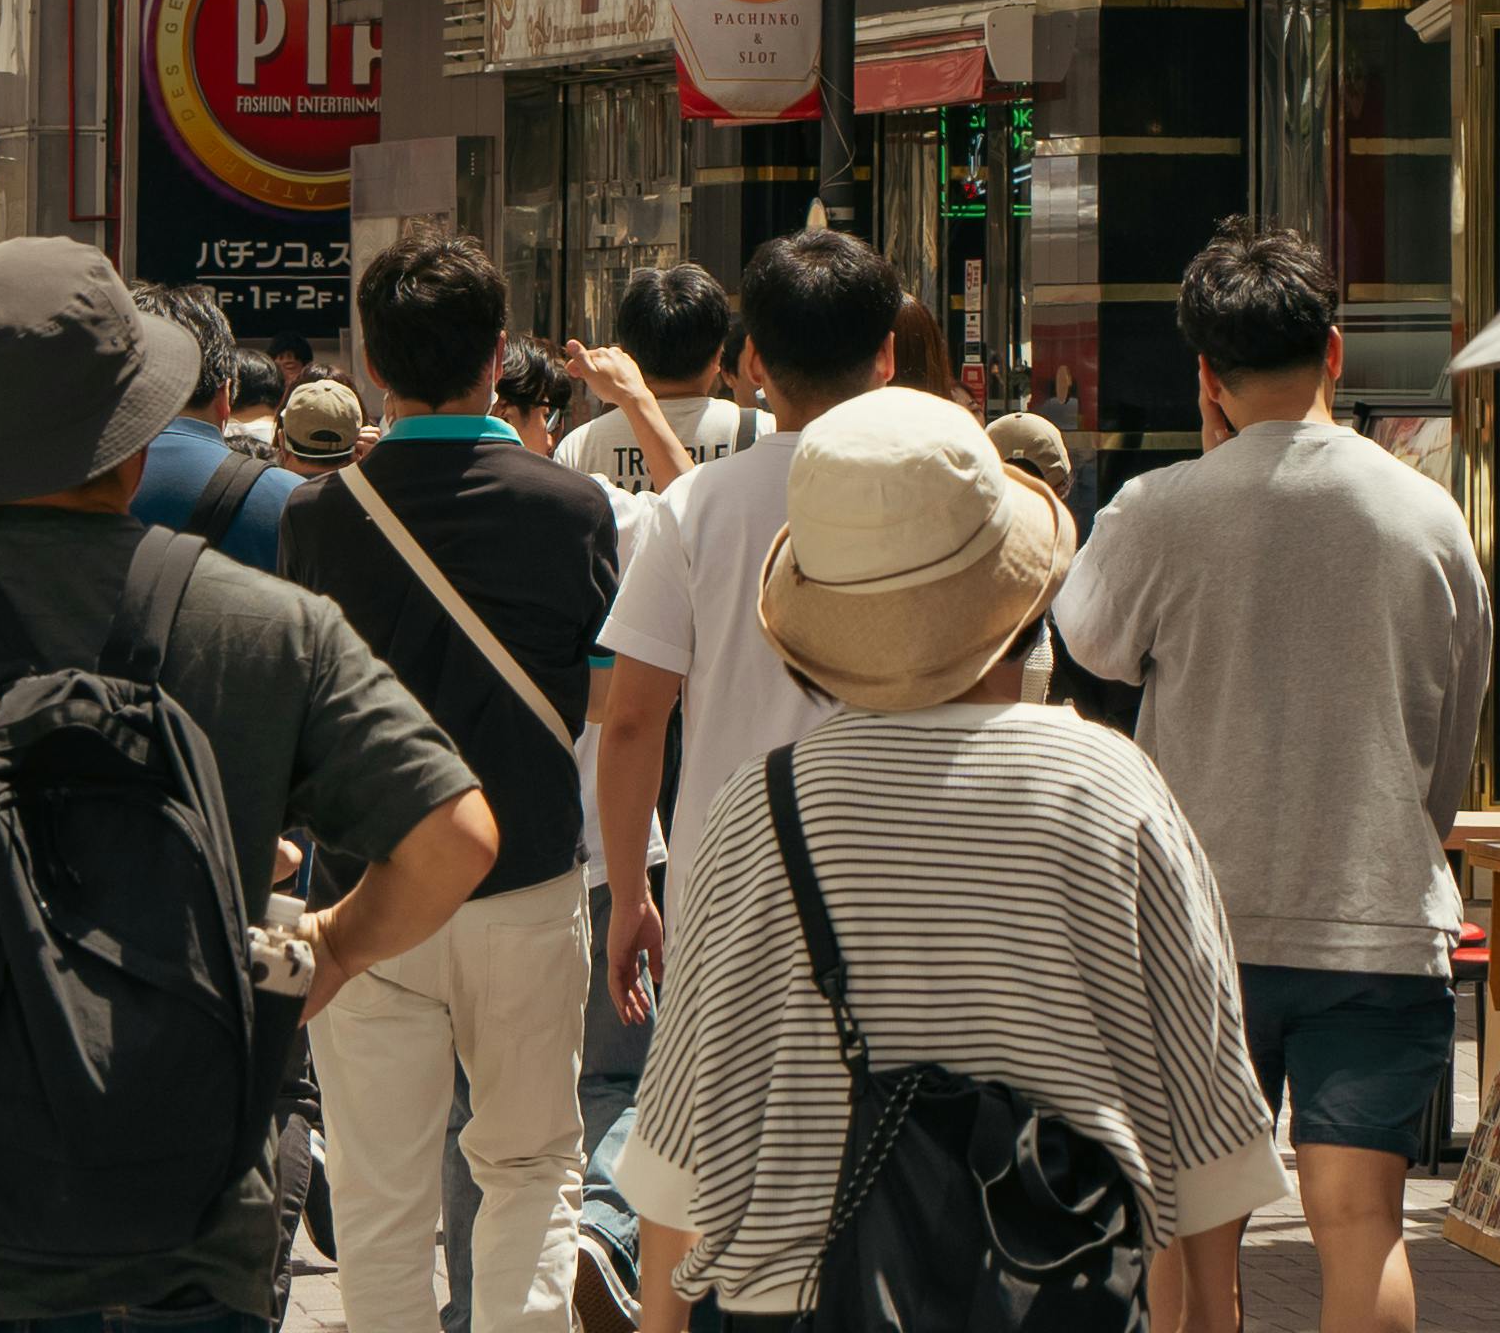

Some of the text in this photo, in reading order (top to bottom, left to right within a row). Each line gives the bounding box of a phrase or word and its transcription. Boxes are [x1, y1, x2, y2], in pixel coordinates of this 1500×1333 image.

[713, 12, 800, 27] PACHINKO
[754, 33, 762, 45] &
[738, 51, 778, 65] SLOT
[236, 95, 382, 114] FASHION ENTERTAINM
